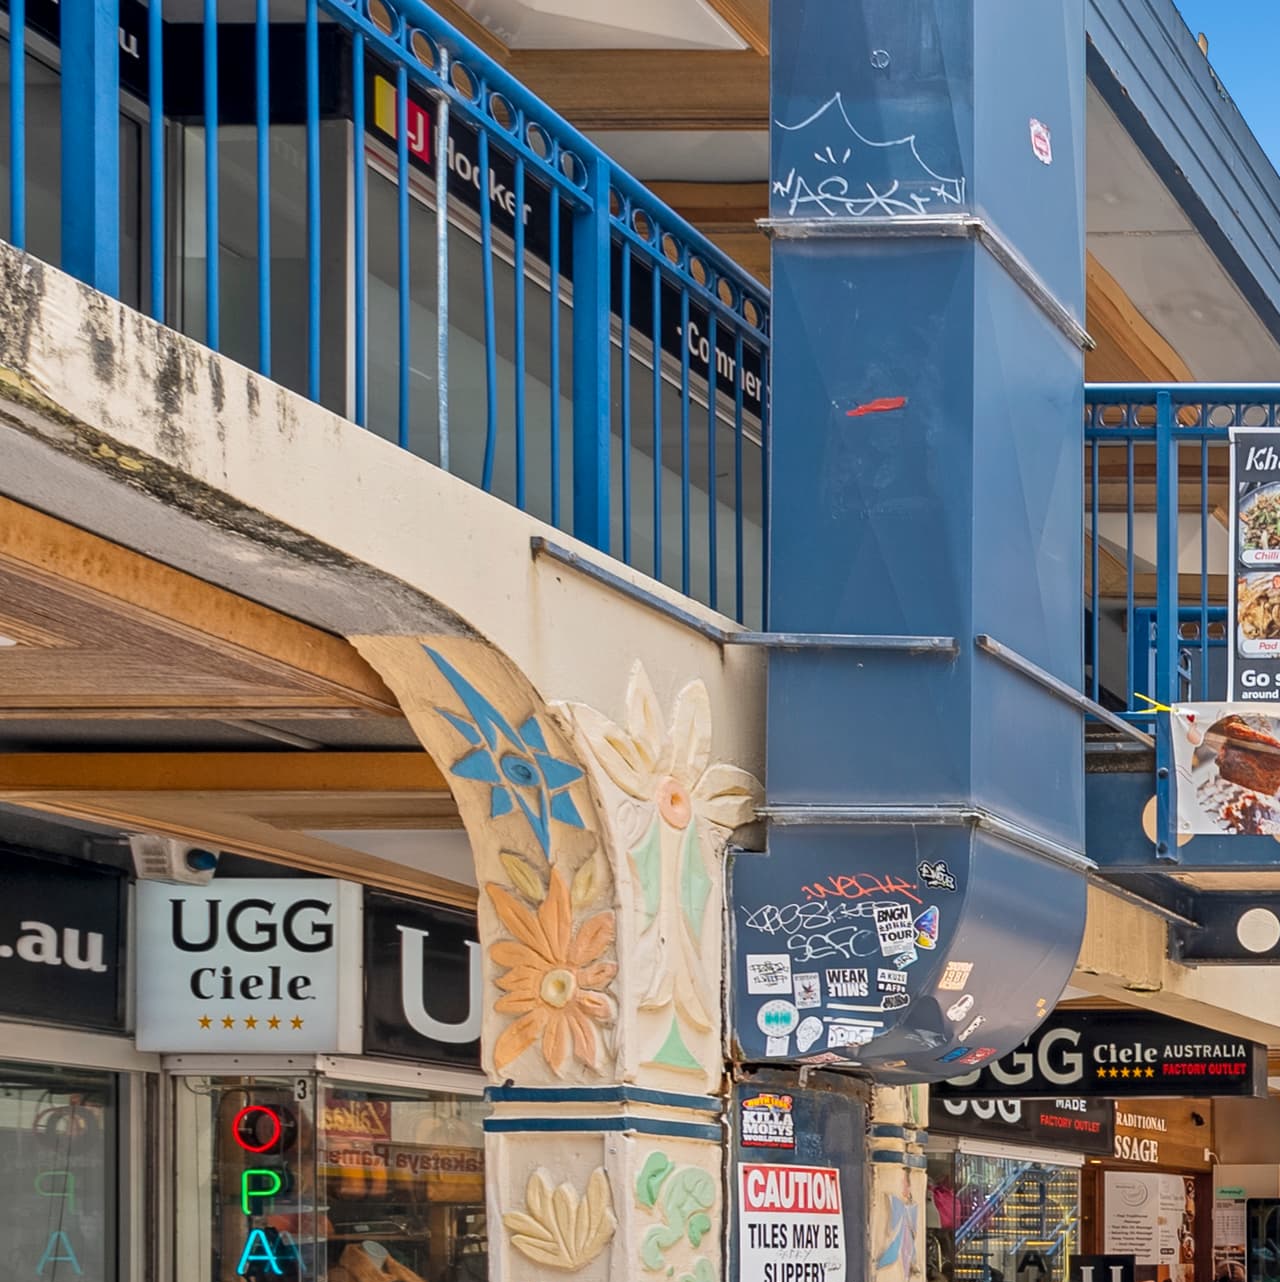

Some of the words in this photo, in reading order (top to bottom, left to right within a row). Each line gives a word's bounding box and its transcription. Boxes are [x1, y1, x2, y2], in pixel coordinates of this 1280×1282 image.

[1254, 551, 1279, 561] Chilli
[1258, 641, 1278, 650] Pad
[1241, 669, 1271, 687] Go
[1241, 689, 1279, 700] around
[170, 897, 335, 954] UGG
[880, 929, 914, 943] TOUR
[189, 965, 317, 1001] Ciele
[827, 969, 867, 984] WEAK
[1093, 1042, 1158, 1064] Ciele
[1163, 1044, 1247, 1058] AUSTRALIA
[1163, 1063, 1205, 1076] FACTORY
[1208, 1062, 1247, 1075] OUTLET
[296, 1079, 309, 1100] 3
[742, 1110, 794, 1127] KILLA
[1040, 1114, 1072, 1130] FACTORY
[1074, 1119, 1101, 1134] OUTLET
[1115, 1111, 1168, 1133] RADITIONAL
[747, 1168, 839, 1211] CAUTION
[748, 1223, 788, 1249] TILES
[793, 1224, 821, 1249] MAY
[824, 1223, 840, 1249] BE
